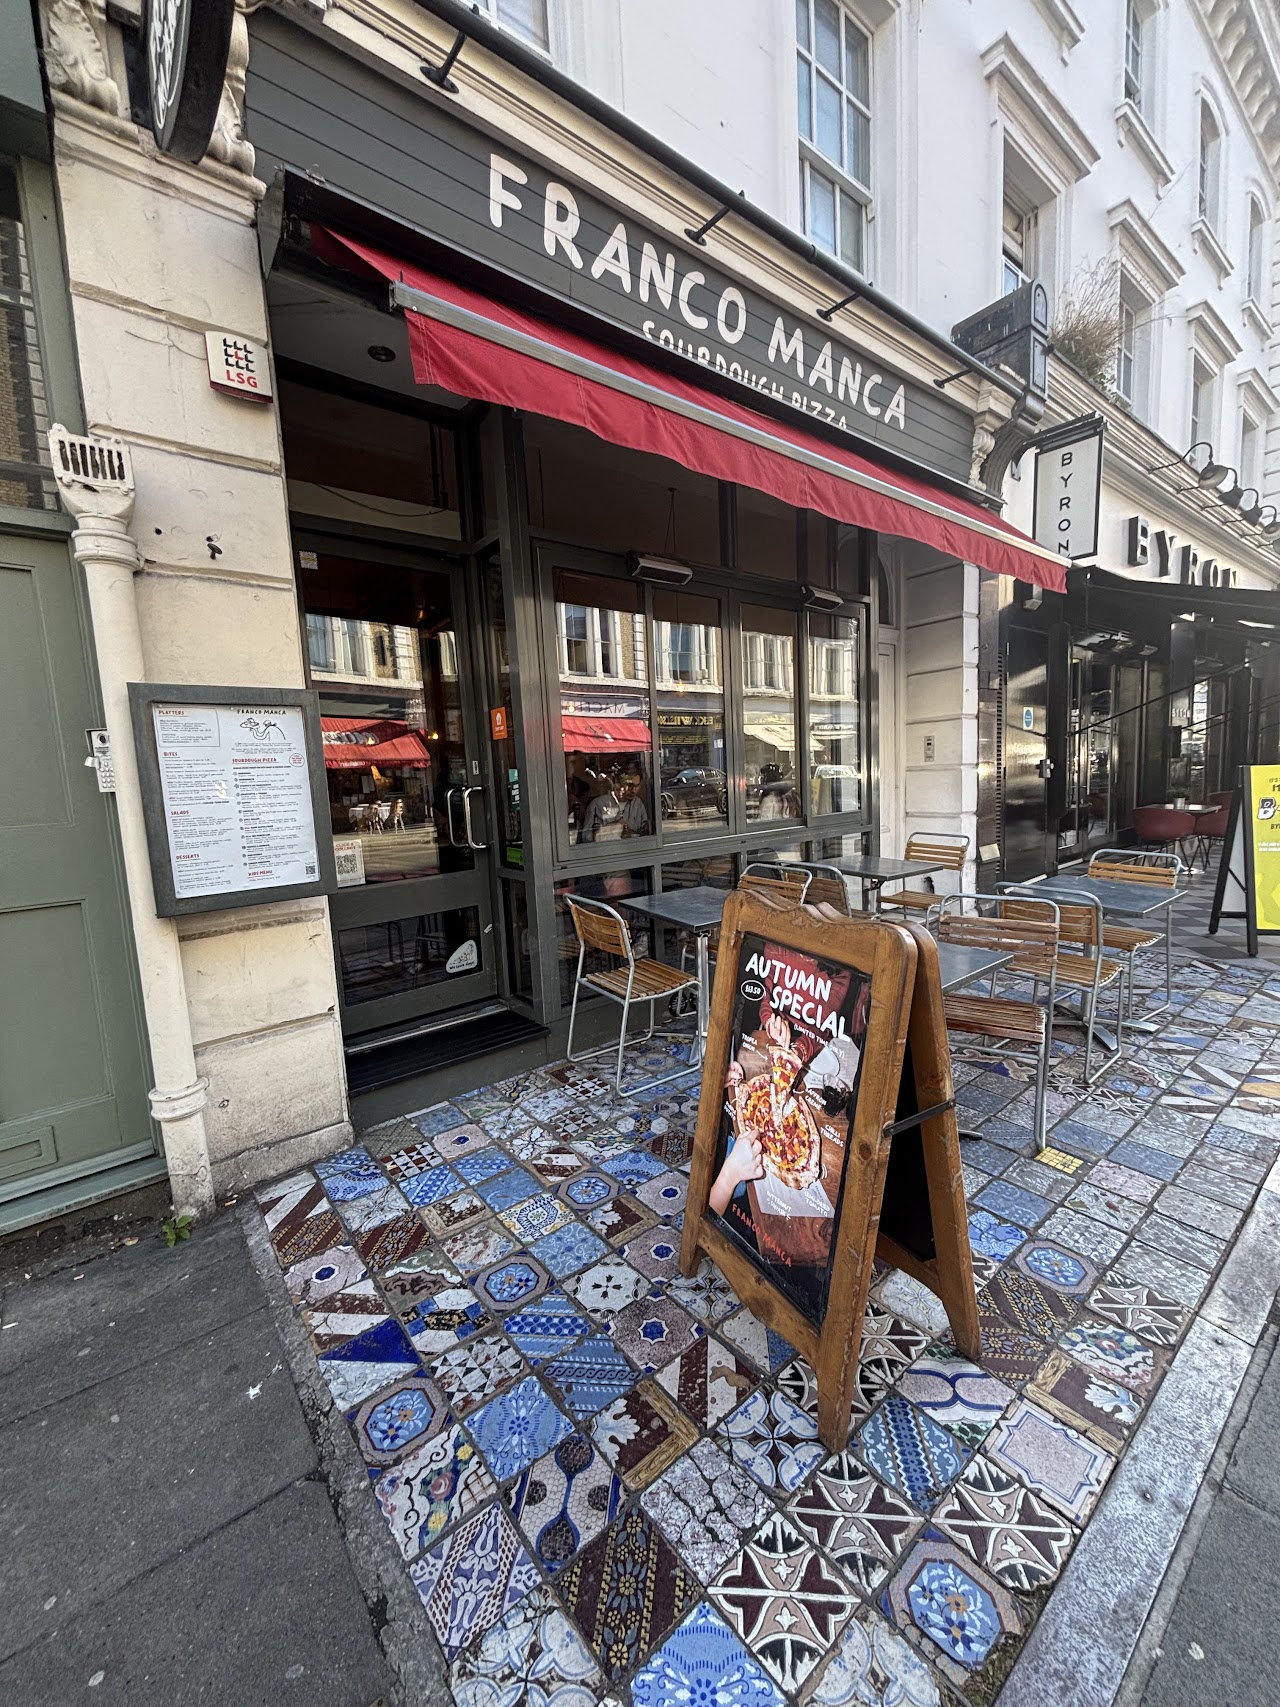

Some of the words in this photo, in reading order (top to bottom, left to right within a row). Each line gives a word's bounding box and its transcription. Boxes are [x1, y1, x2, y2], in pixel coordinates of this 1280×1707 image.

[488, 152, 748, 345] FRANCO
[767, 316, 906, 430] MANCA
[226, 369, 258, 389] LSG
[1057, 451, 1074, 559] BYRON
[744, 952, 832, 1003] AUTUMN
[769, 985, 852, 1043] SPECIAL
[815, 1035, 829, 1047] TIME
[820, 1126, 845, 1148] THREADS
[825, 1124, 841, 1139] CHILLI
[805, 1197, 828, 1217] TOMATO
[732, 1203, 761, 1235] FRANCO
[762, 1232, 792, 1268] MANCA
